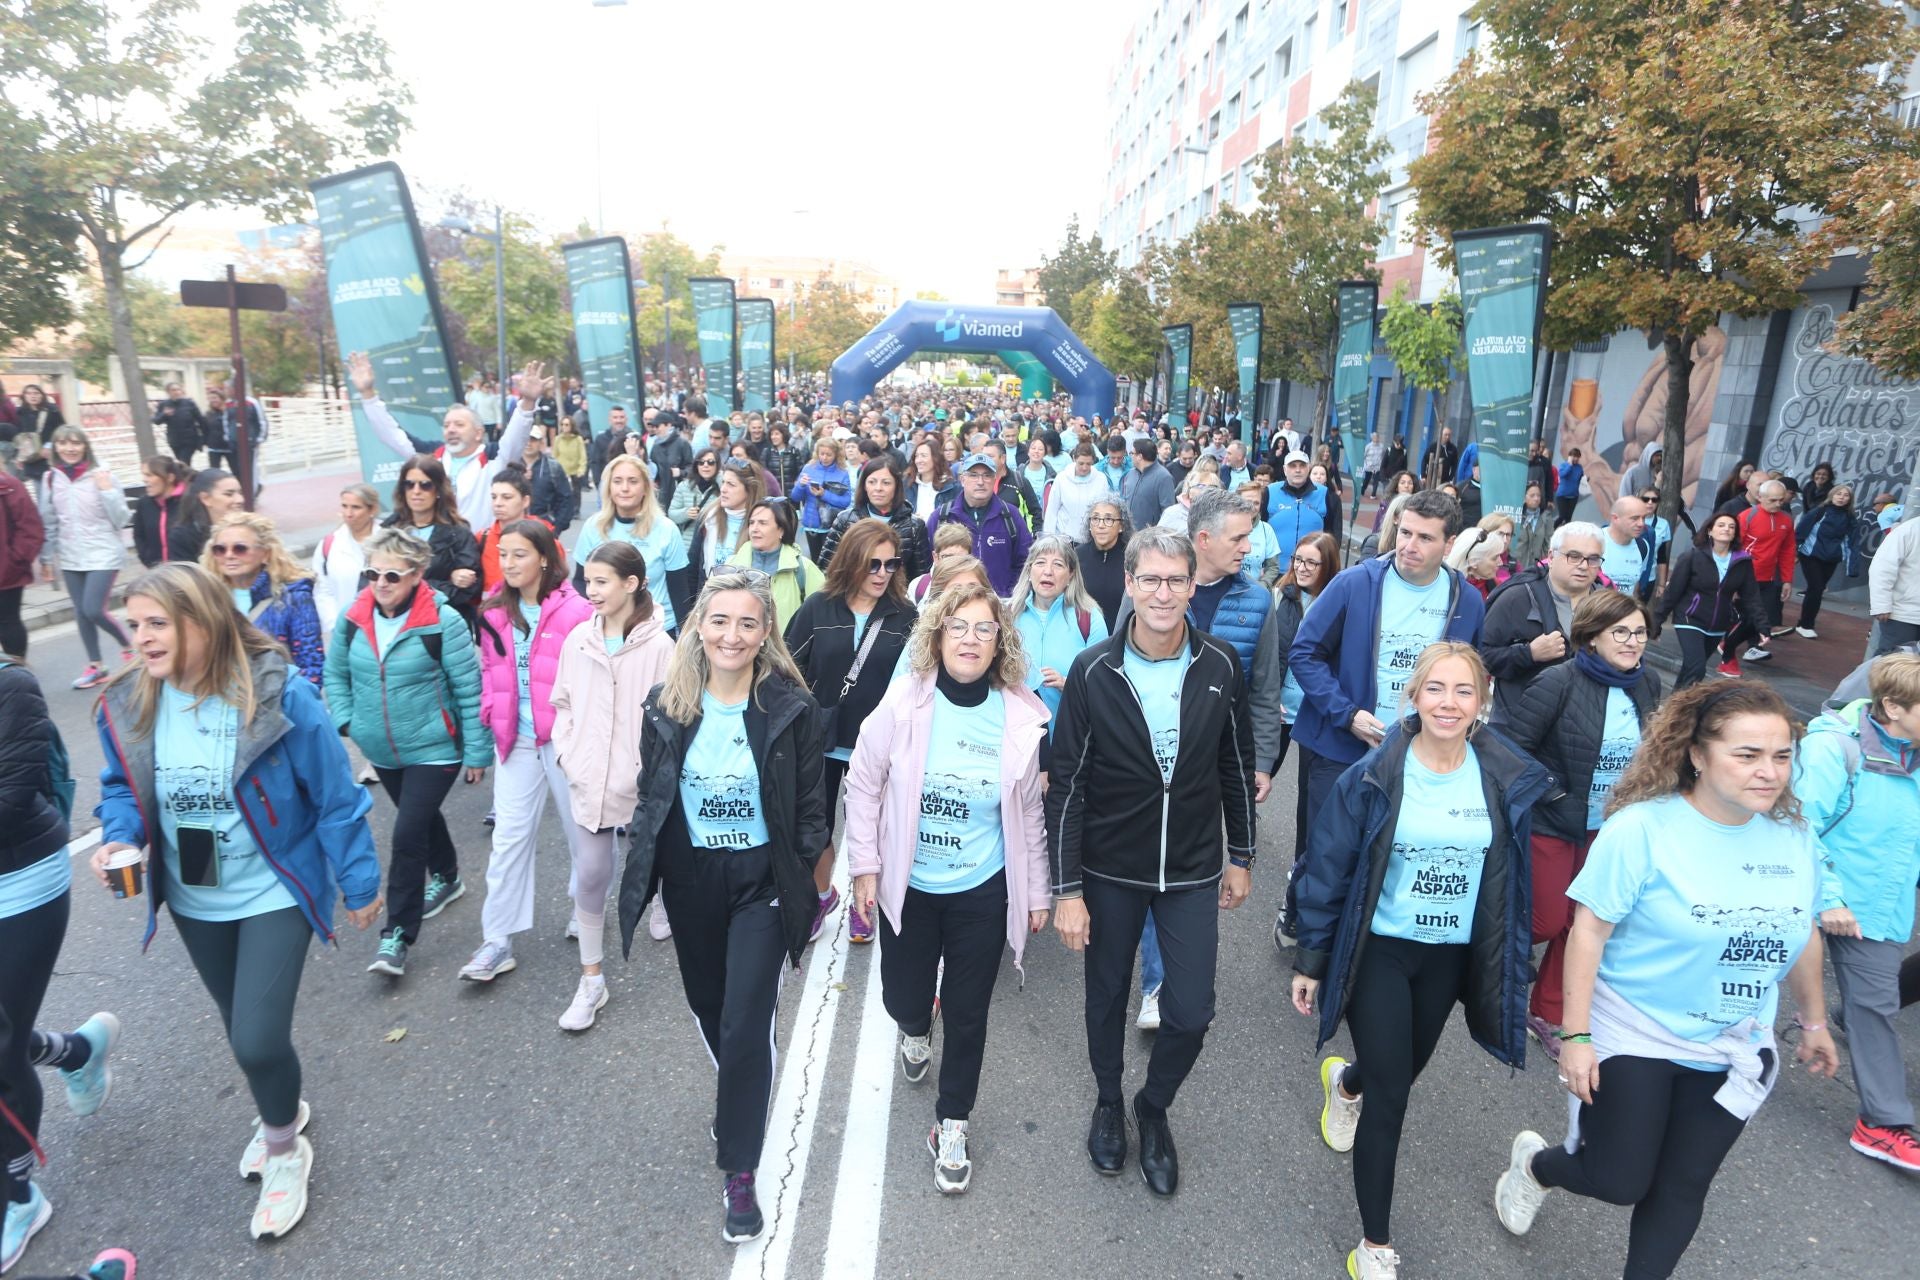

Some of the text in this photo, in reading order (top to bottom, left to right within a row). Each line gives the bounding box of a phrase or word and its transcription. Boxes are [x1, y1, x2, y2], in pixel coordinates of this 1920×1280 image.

[964, 320, 1023, 338] viamed
[1783, 387, 1907, 430] Pilates
[1394, 650, 1418, 660] Marc
[702, 798, 750, 808] Marcha
[921, 793, 967, 808] Marcha
[698, 808, 755, 818] ASPACE
[1417, 870, 1466, 883] Marcha
[1411, 880, 1469, 895] ASPACE
[1728, 937, 1784, 948] Marcha
[1720, 948, 1788, 963] ASPACE
